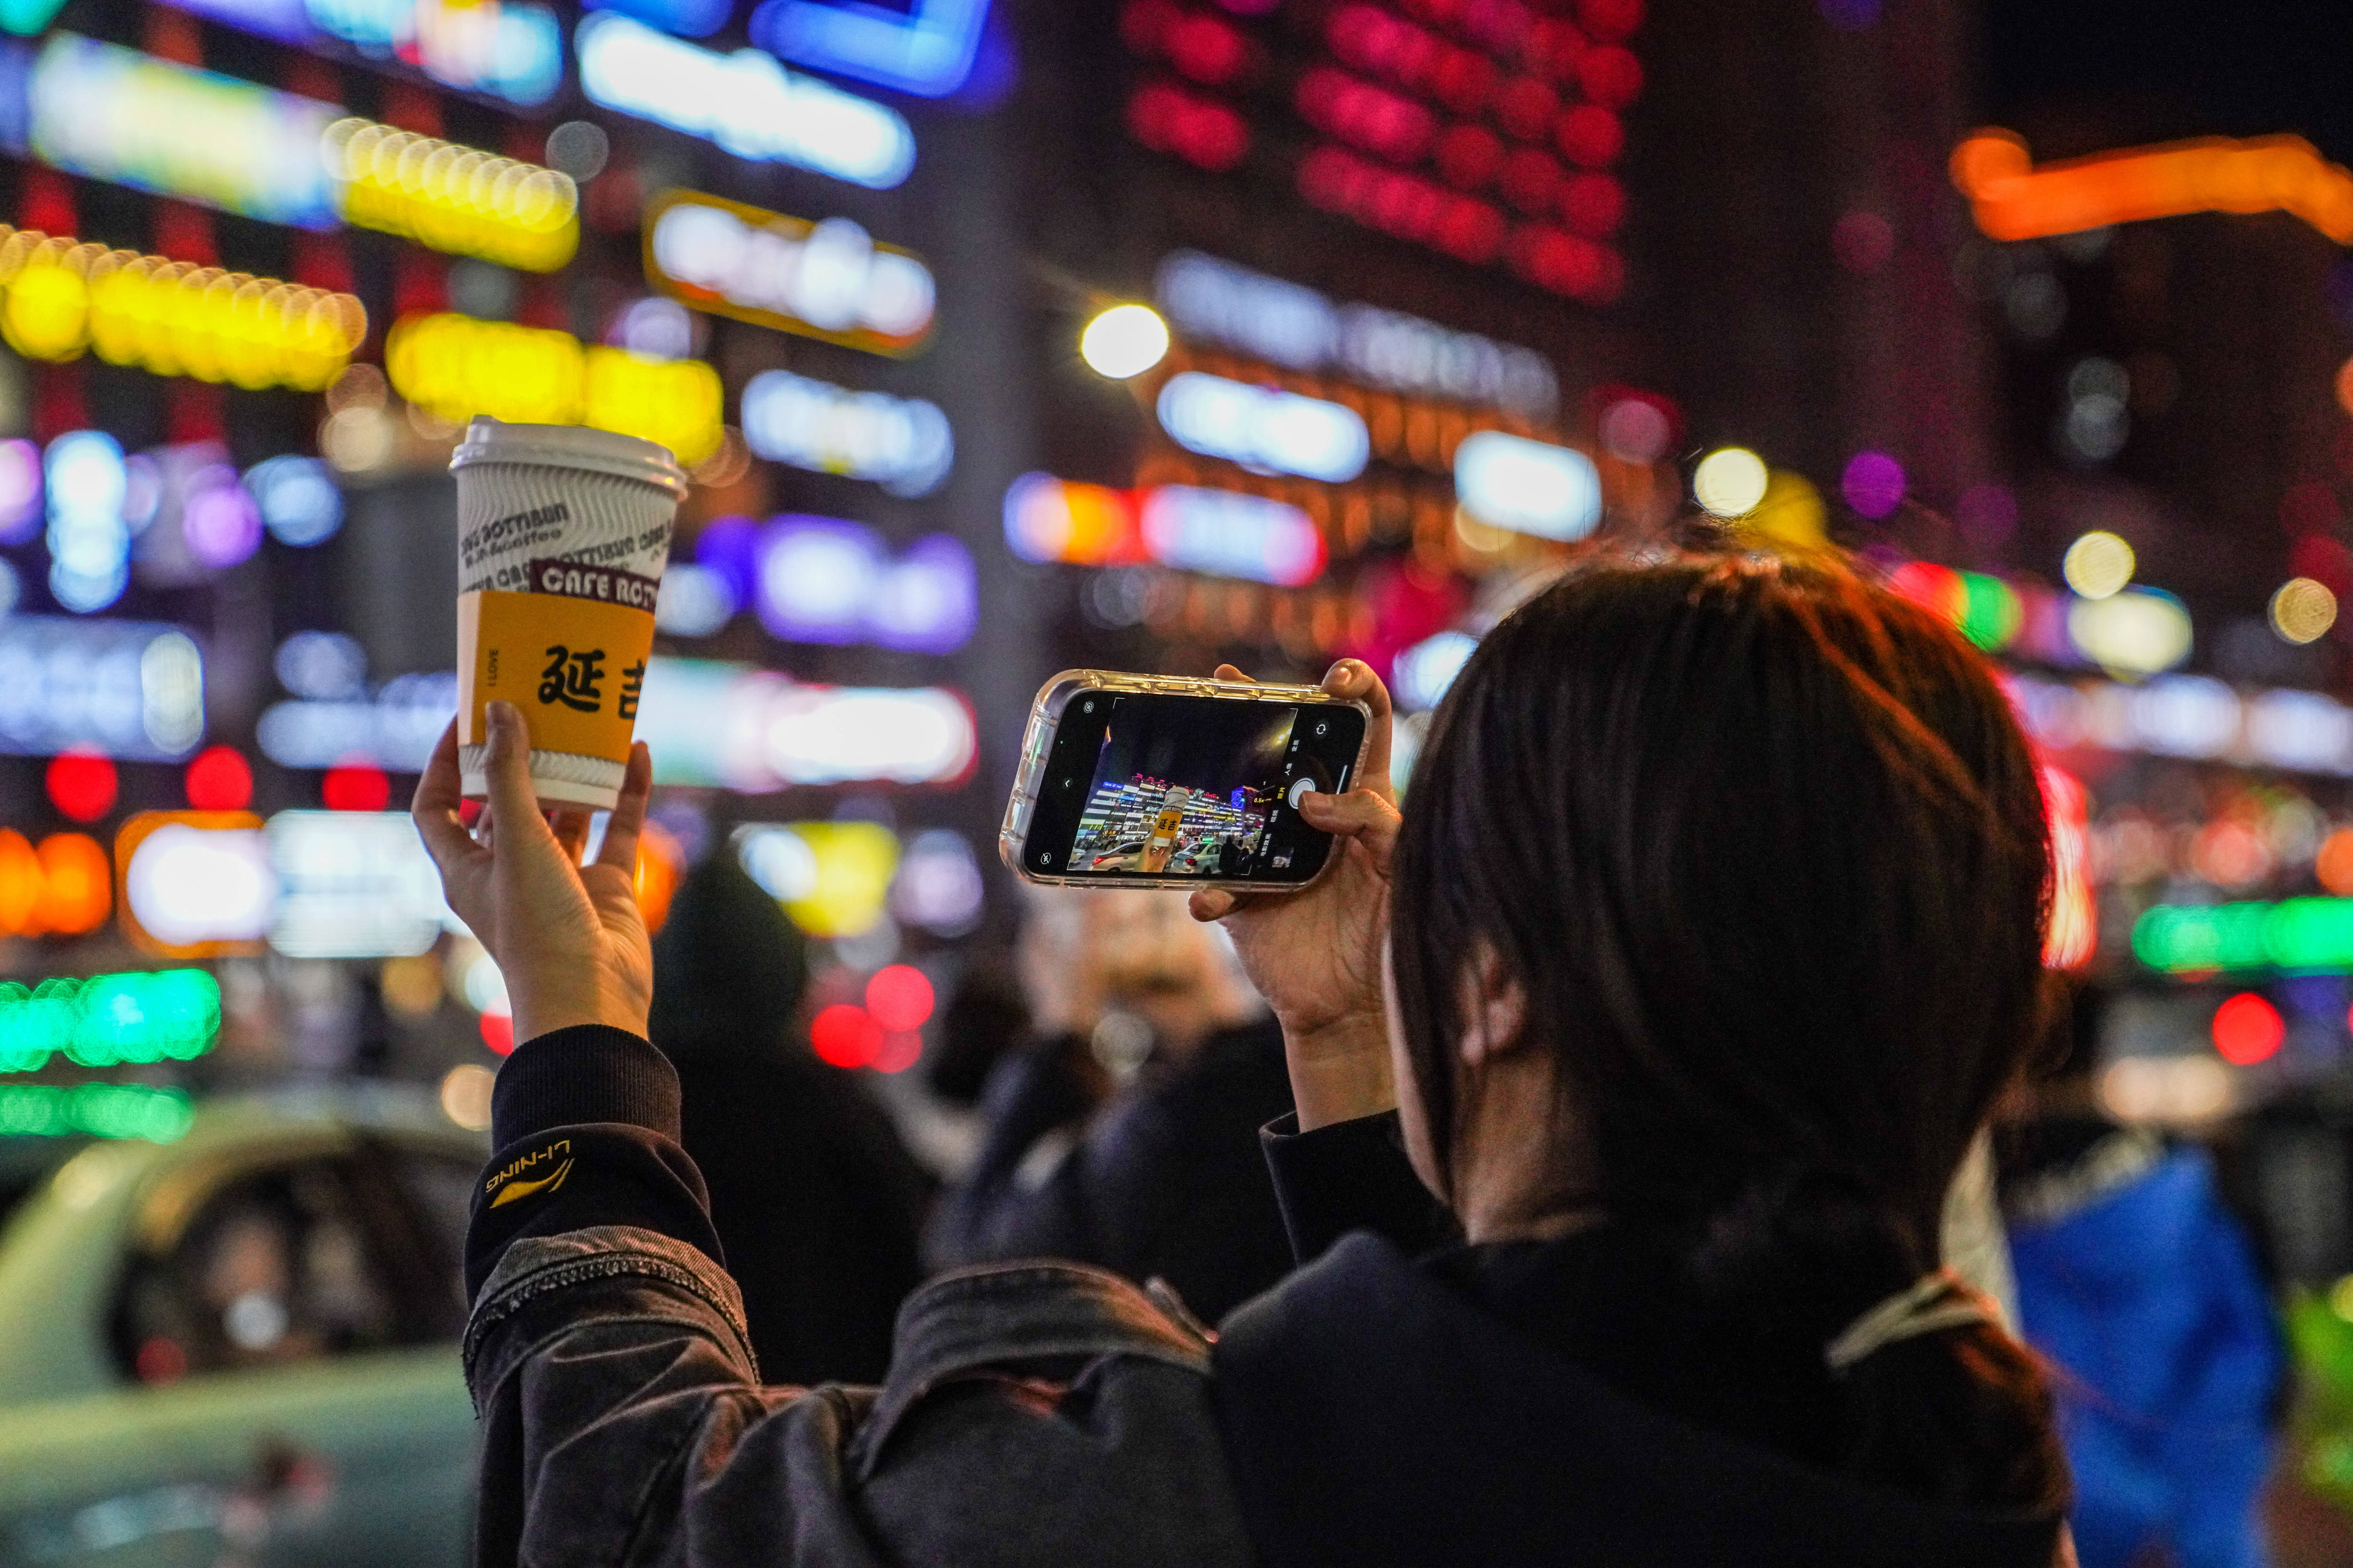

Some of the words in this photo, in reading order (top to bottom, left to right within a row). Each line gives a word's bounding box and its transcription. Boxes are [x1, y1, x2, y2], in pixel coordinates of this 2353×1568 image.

[542, 567, 609, 599] CAFE
[538, 645, 645, 720] 延吉
[1291, 739, 1300, 752] 全景
[1284, 763, 1293, 776] 人像
[1277, 787, 1286, 799] 照片
[1270, 810, 1279, 823] 视频
[1158, 818, 1177, 831] 延吉
[1260, 833, 1272, 857] 电影效果
[486, 1140, 570, 1193] LI-NING
